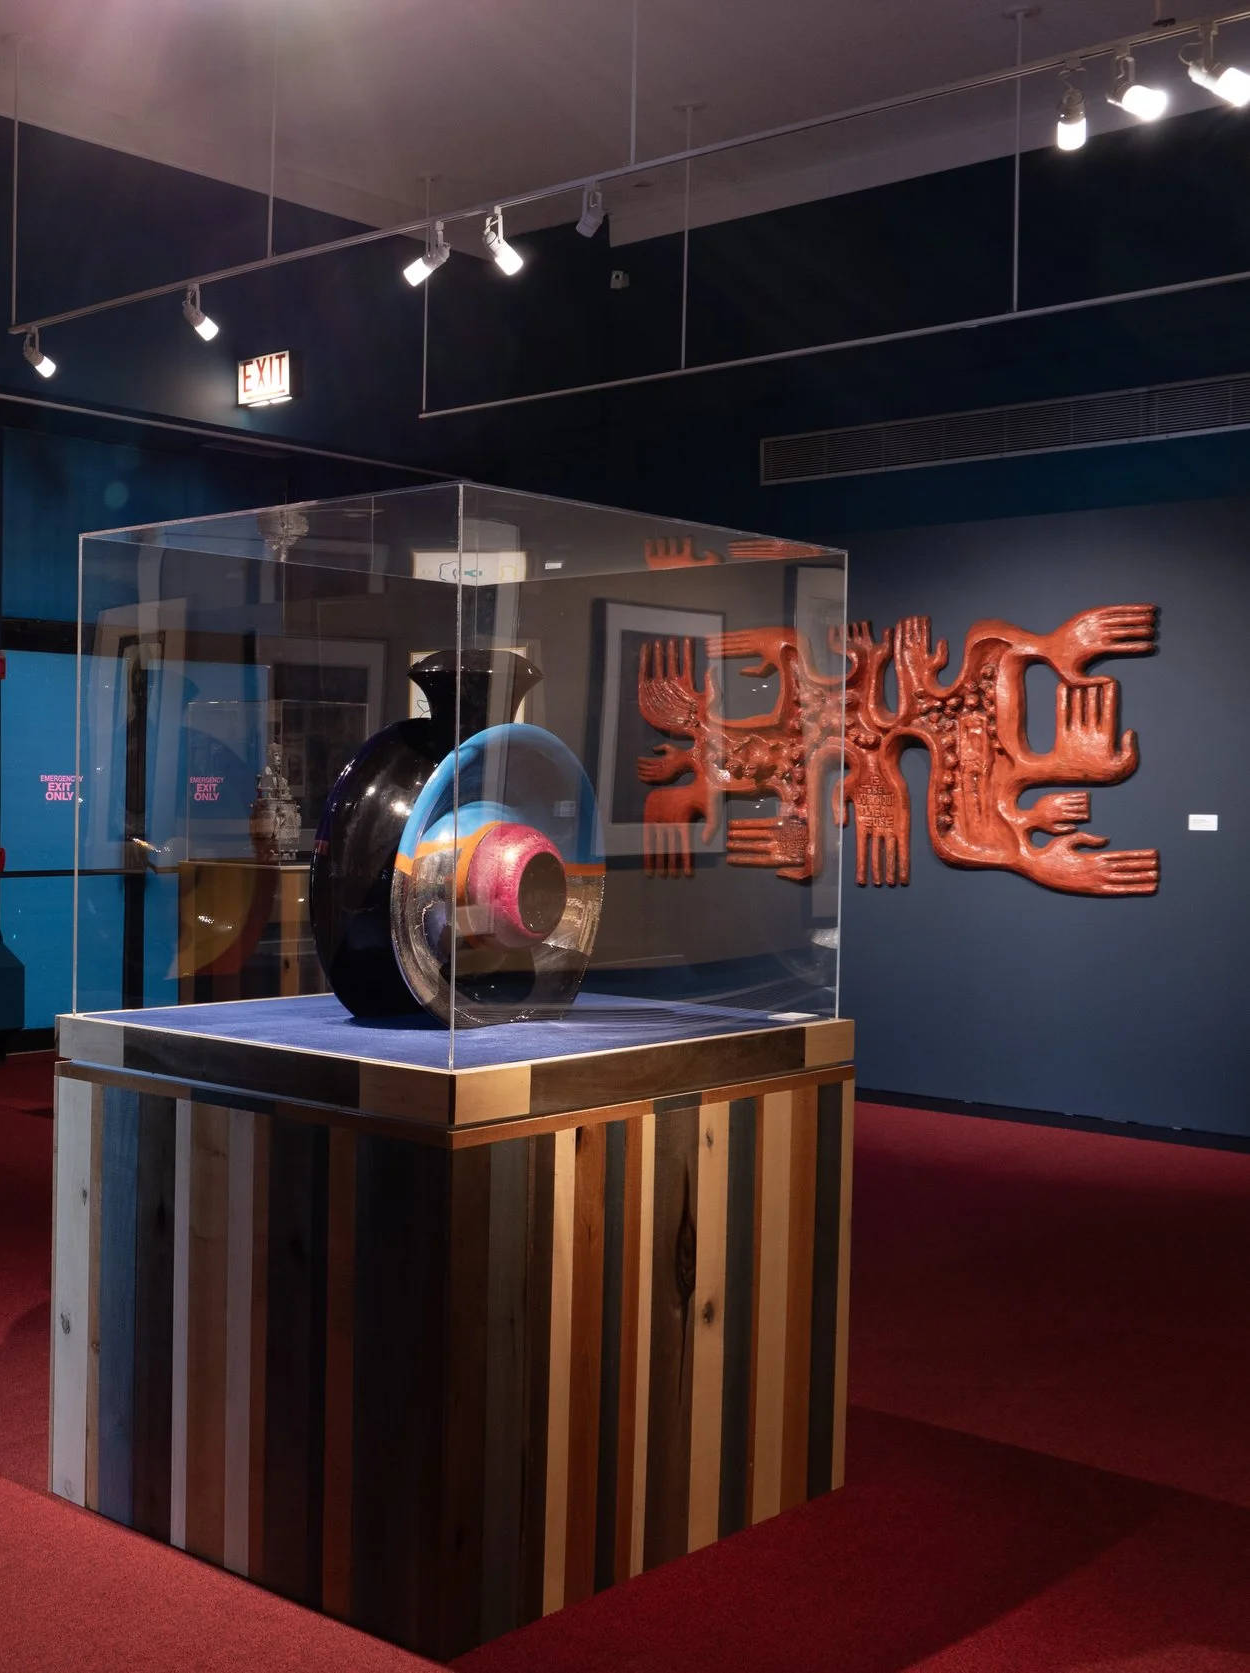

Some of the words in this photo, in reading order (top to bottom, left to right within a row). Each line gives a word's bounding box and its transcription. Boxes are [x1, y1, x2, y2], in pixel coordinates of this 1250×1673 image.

[243, 354, 286, 393] EXIT
[48, 782, 71, 791] EXIT
[196, 783, 217, 792] EXIT
[45, 791, 74, 801] ONLY
[194, 792, 220, 801] ONLY
